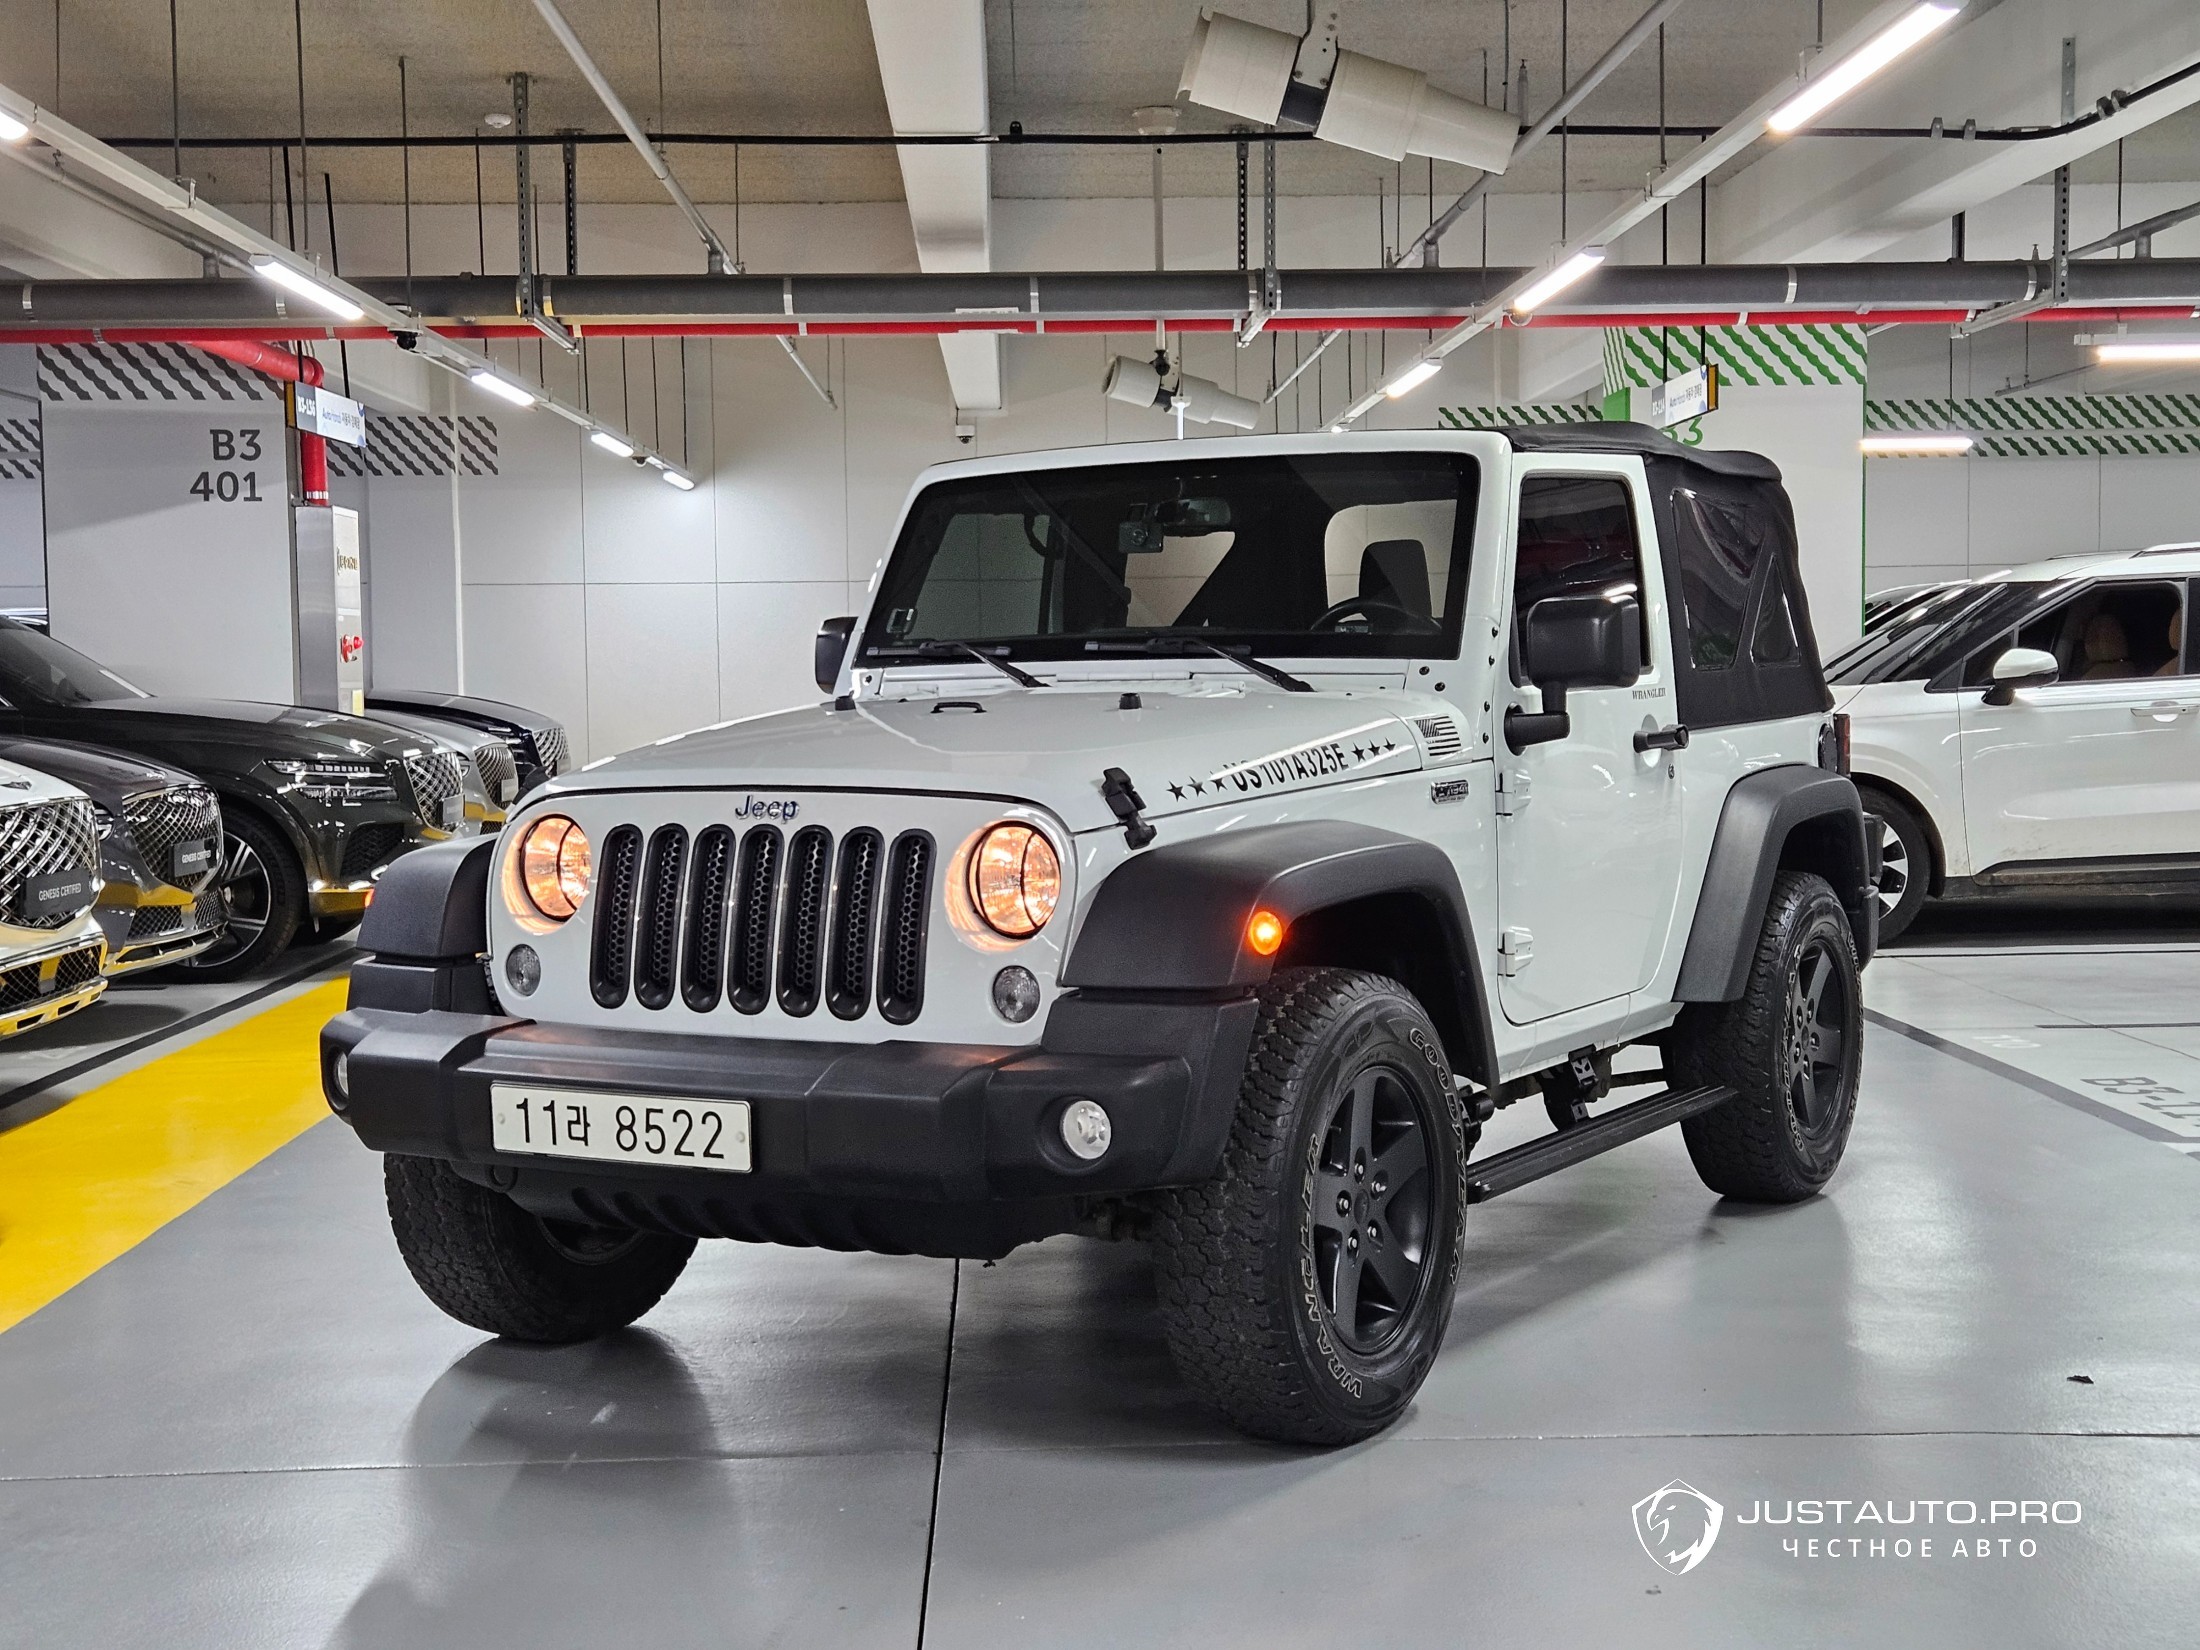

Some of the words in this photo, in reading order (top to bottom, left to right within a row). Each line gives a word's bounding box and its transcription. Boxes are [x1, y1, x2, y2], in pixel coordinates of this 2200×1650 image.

[209, 429, 262, 461] B3
[189, 471, 262, 502] 401
[1632, 687, 1667, 701] WRANGLER
[735, 794, 800, 824] Jeep
[182, 852, 197, 864] GENESIS
[39, 887, 60, 902] GENESIS
[61, 883, 82, 897] CERTIFIED
[516, 1097, 591, 1147] 11라
[615, 1105, 725, 1160] 8522
[1408, 1027, 1467, 1286] GOODYEAR
[1300, 1132, 1364, 1399] WRANGLER
